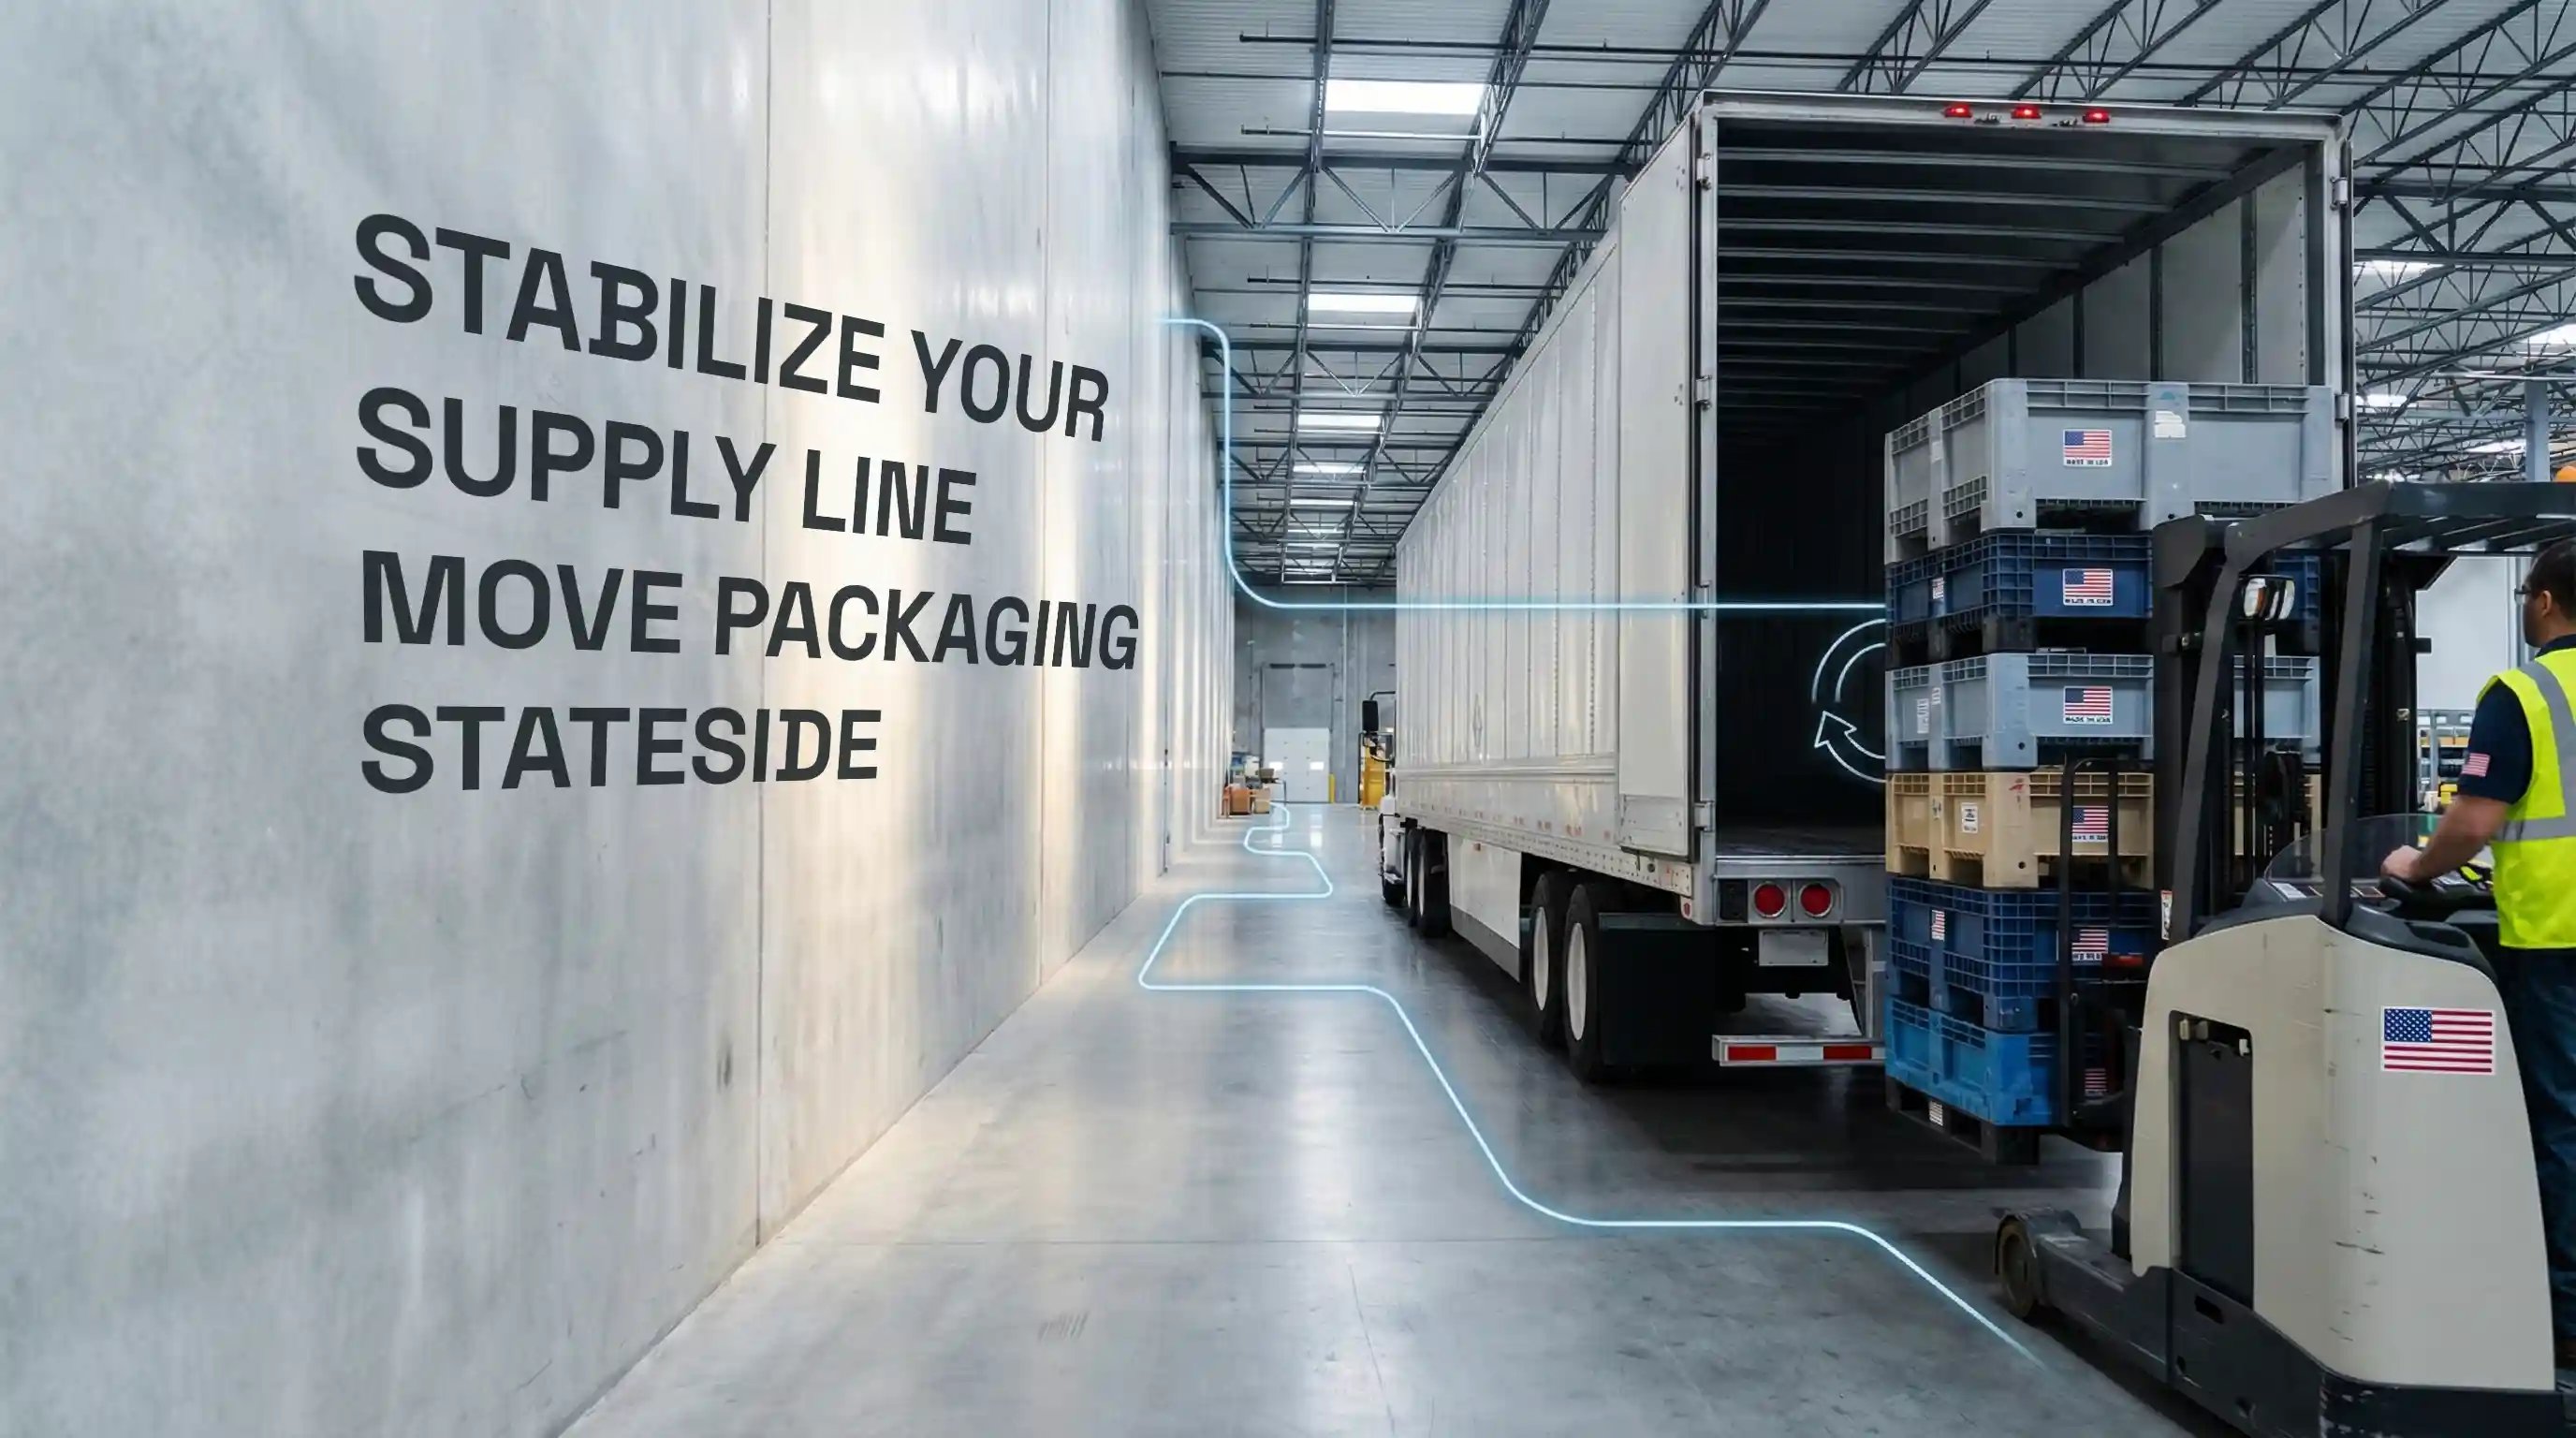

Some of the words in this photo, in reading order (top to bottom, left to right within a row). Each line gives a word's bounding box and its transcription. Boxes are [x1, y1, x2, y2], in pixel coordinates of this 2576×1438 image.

[354, 213, 886, 404] STABILIZE
[911, 330, 1109, 443] YOUR
[357, 387, 777, 522] SUPPLY
[802, 448, 977, 545] LINE
[362, 550, 683, 653] MOVE
[715, 576, 1139, 670] PACKAGING
[361, 703, 882, 794] STATESIDE
